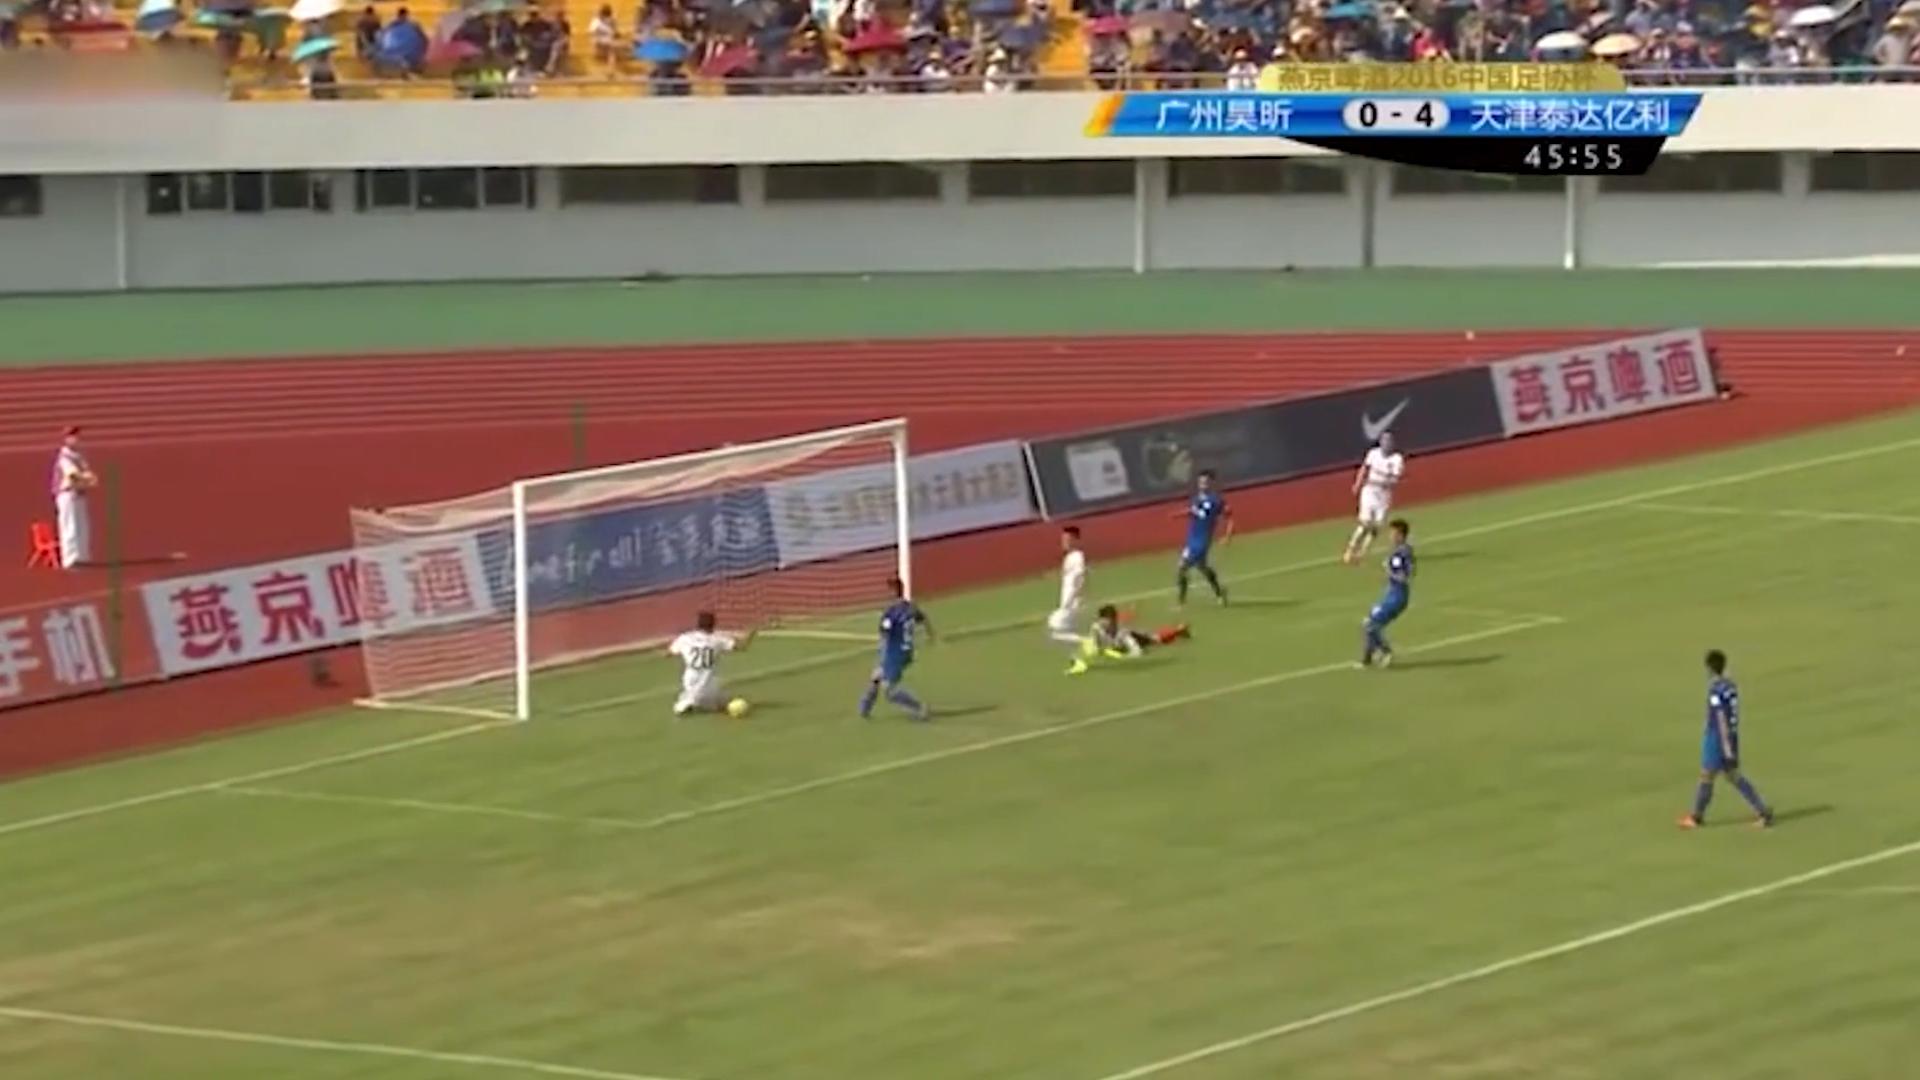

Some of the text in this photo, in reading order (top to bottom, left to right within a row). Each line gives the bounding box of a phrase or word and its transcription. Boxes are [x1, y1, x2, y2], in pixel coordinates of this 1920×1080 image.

[1508, 339, 1702, 422] 燕京啤酒
[169, 545, 476, 661] 燕京啤酒
[690, 646, 714, 670] 20
